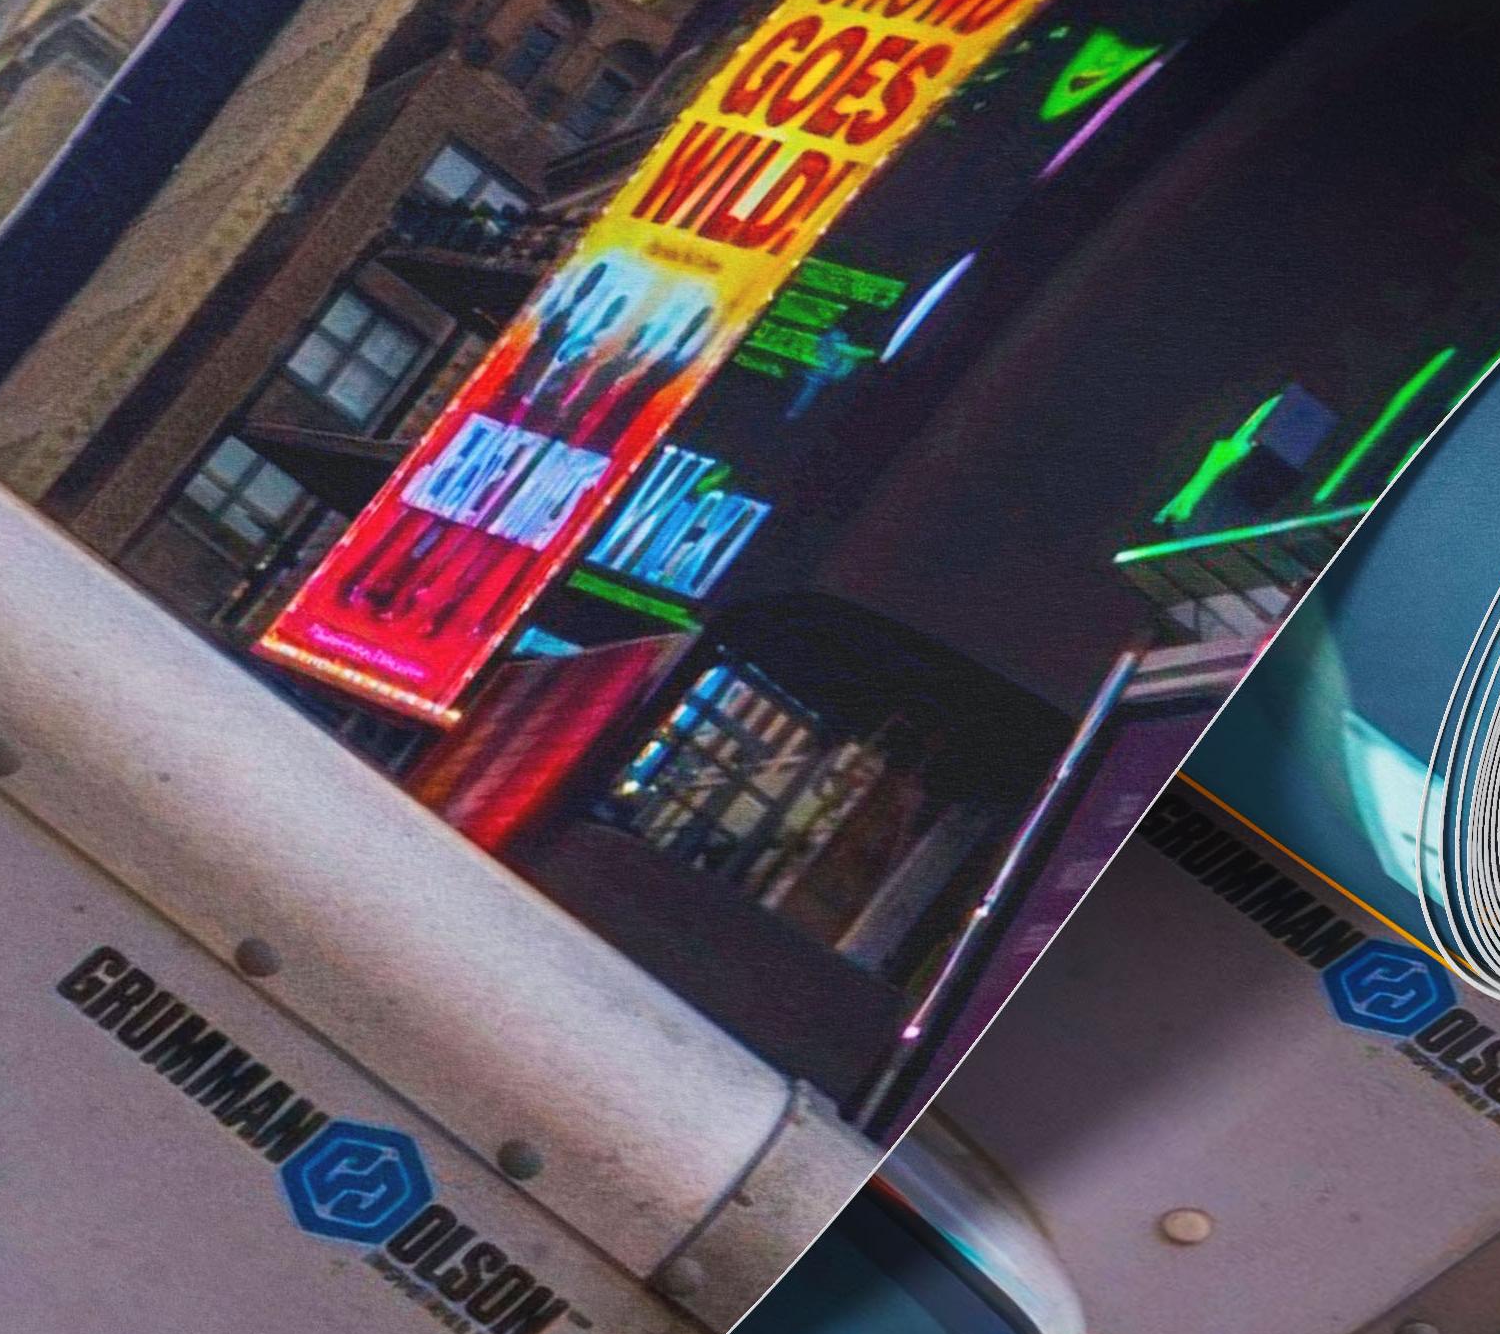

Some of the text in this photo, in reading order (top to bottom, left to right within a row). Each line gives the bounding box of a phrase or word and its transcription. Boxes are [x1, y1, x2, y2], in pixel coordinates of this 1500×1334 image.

[722, 16, 952, 145] GOES
[631, 122, 864, 255] WILD!
[56, 945, 326, 1165] GRUMMAN
